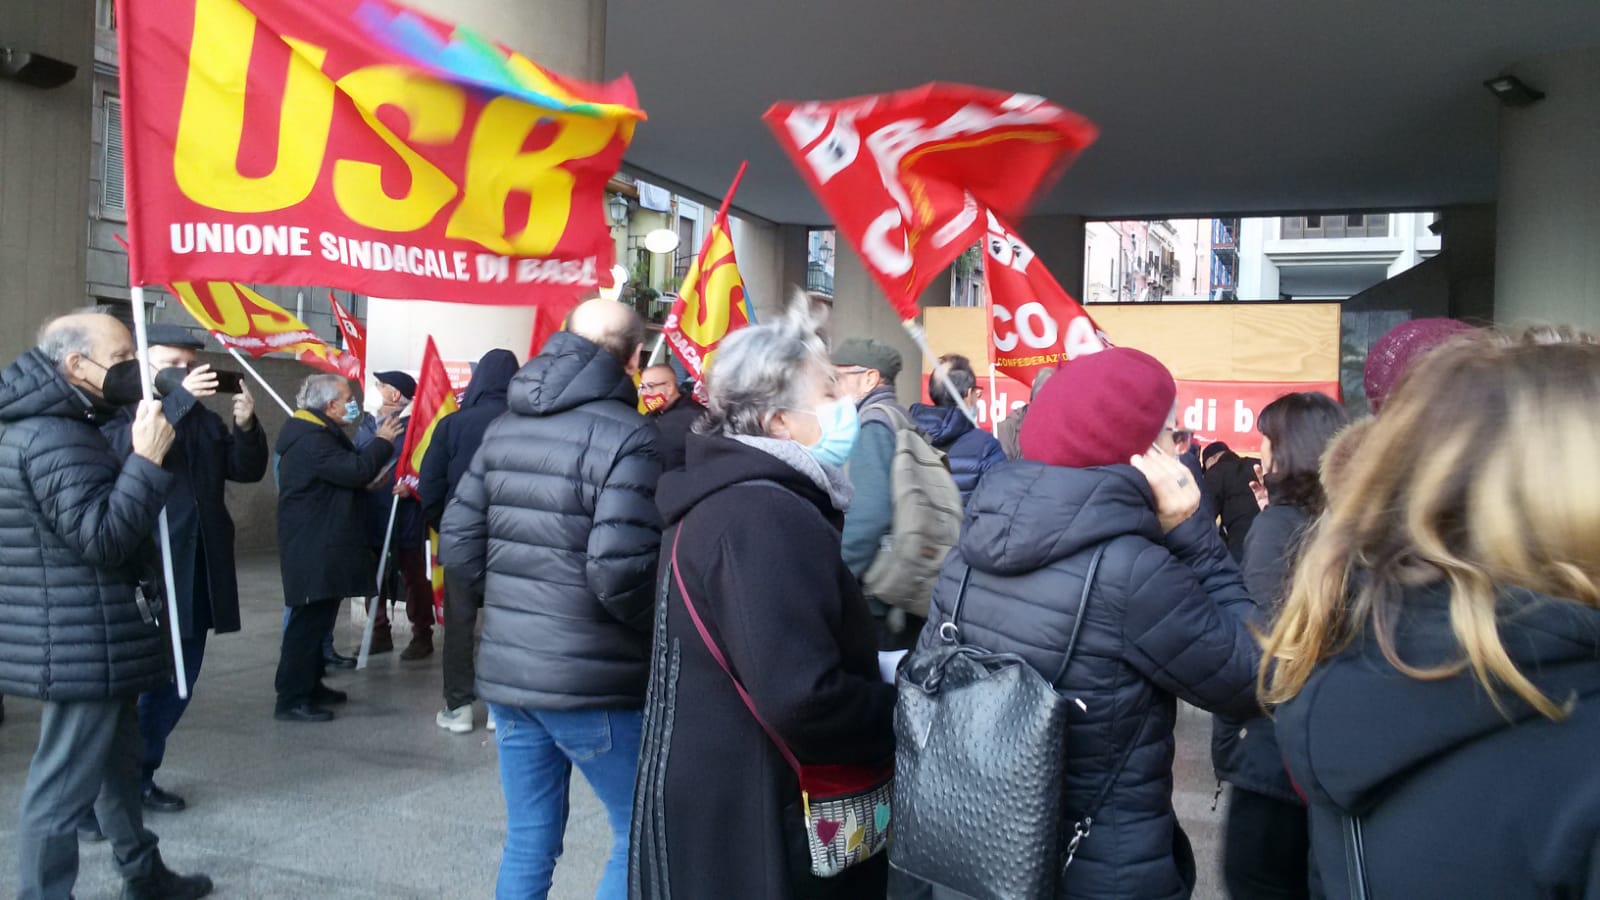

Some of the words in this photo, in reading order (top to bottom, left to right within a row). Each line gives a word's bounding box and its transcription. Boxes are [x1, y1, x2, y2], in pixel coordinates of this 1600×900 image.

[174, 0, 634, 256] USB
[170, 222, 312, 257] UNIONE
[319, 231, 471, 282] SINDACALE
[475, 253, 510, 283] DI
[515, 256, 598, 286] BASE
[1184, 398, 1217, 431] di
[1234, 400, 1254, 433] b
